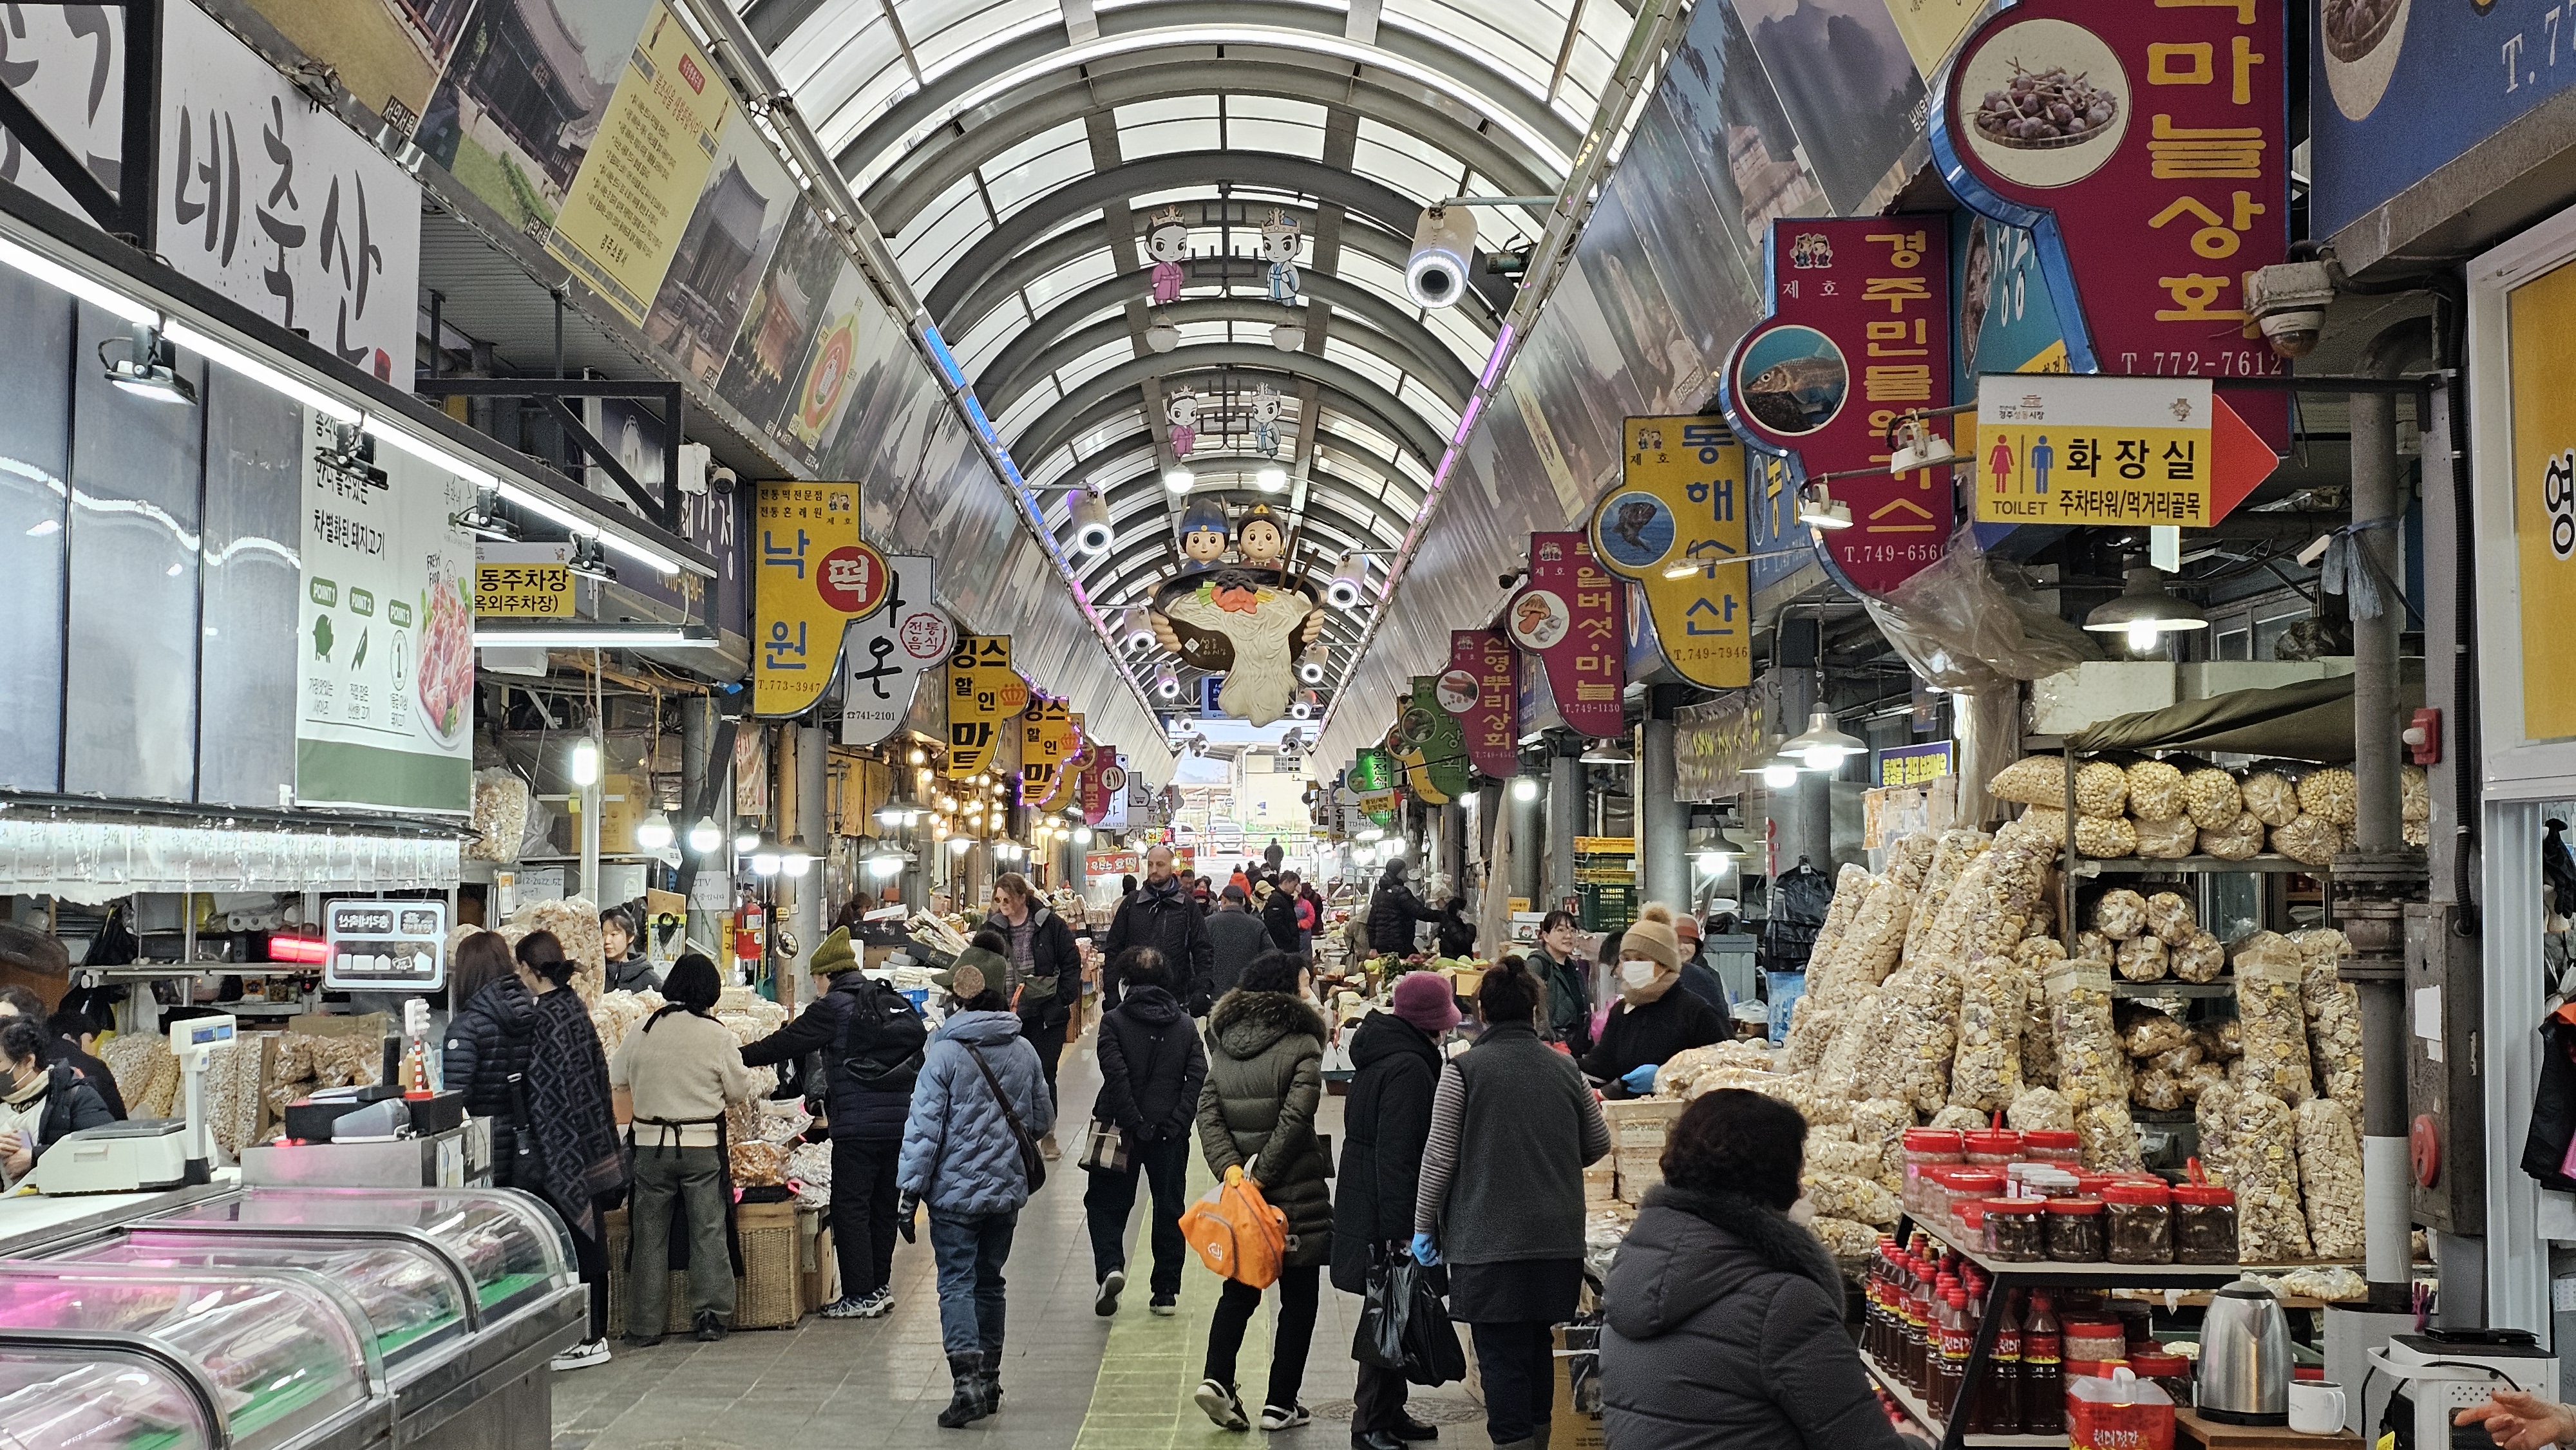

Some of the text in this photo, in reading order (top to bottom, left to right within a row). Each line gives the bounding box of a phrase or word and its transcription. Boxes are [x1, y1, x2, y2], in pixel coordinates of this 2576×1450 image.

[1999, 411, 2044, 420] 경주성동시장
[1993, 501, 2048, 514] TOILET
[2060, 489, 2201, 520] 주차타워/먹거리골목
[314, 509, 385, 561] 차별화된 돼지고기
[1682, 425, 1738, 635] 동해수산
[475, 569, 568, 592] 동주차장
[829, 554, 869, 603] 떡
[313, 584, 331, 602] POINT
[764, 529, 810, 670] 낙원
[909, 621, 940, 636] 전통
[908, 636, 938, 651] 음식
[952, 639, 1007, 668] 킹스
[1674, 646, 1748, 661] T.749-7946
[758, 679, 820, 693] T.773-3947
[856, 711, 895, 721] 741-2101
[1564, 704, 1620, 713] T.749-1130
[952, 722, 993, 769] 마트
[1025, 764, 1056, 798] 마트
